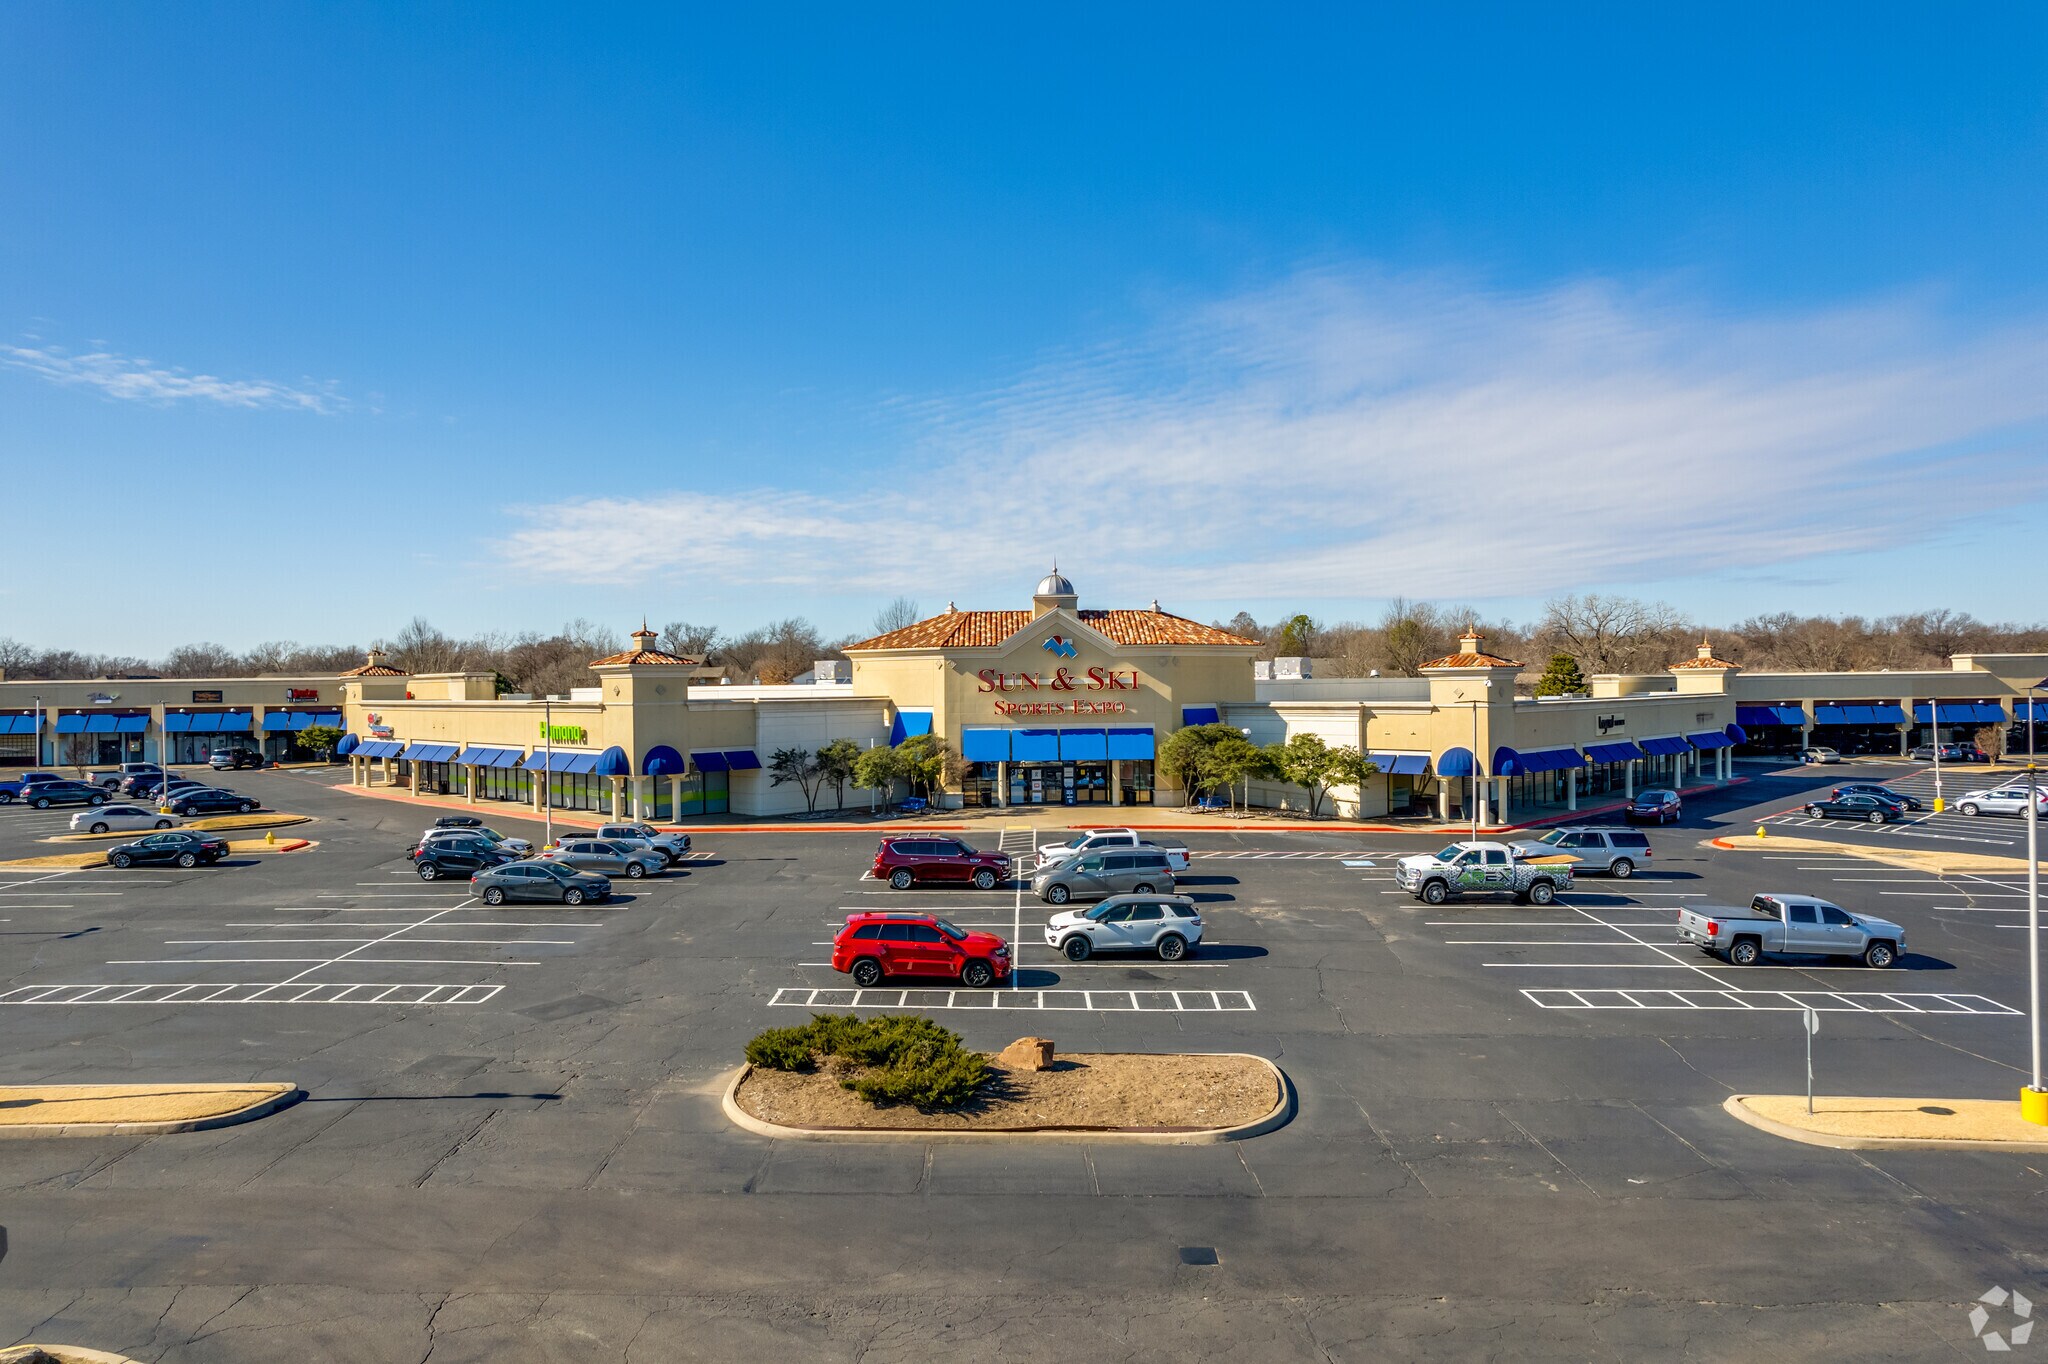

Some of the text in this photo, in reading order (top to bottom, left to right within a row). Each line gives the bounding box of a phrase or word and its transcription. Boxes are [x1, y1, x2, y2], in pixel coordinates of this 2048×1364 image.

[978, 666, 1140, 693] SUN & SKI
[994, 699, 1126, 716] SPORTS EXPO
